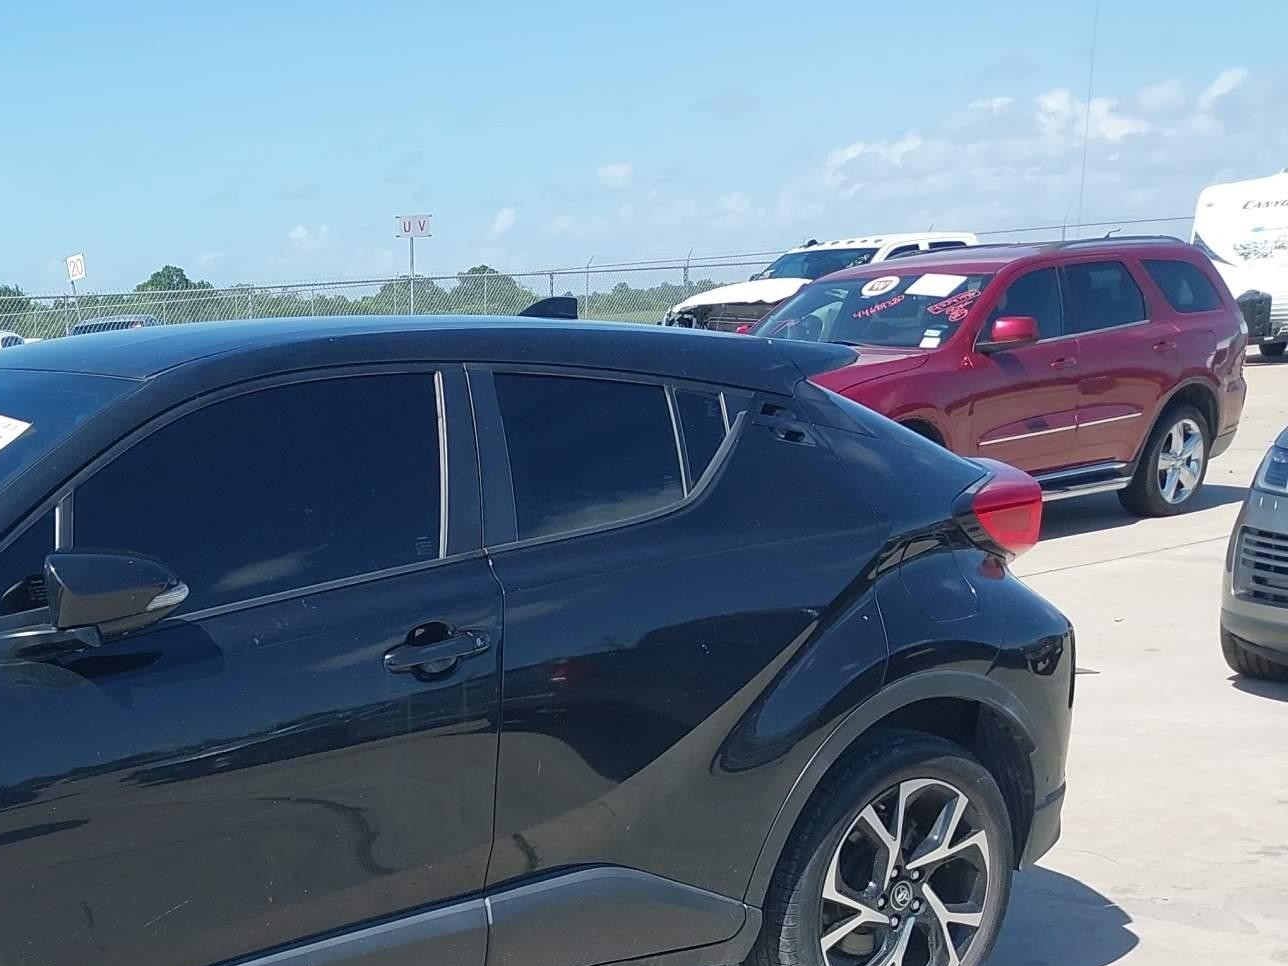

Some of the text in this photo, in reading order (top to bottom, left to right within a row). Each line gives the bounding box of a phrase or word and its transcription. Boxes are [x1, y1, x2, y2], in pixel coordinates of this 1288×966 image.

[403, 220, 425, 232] U V
[69, 258, 83, 277] 20
